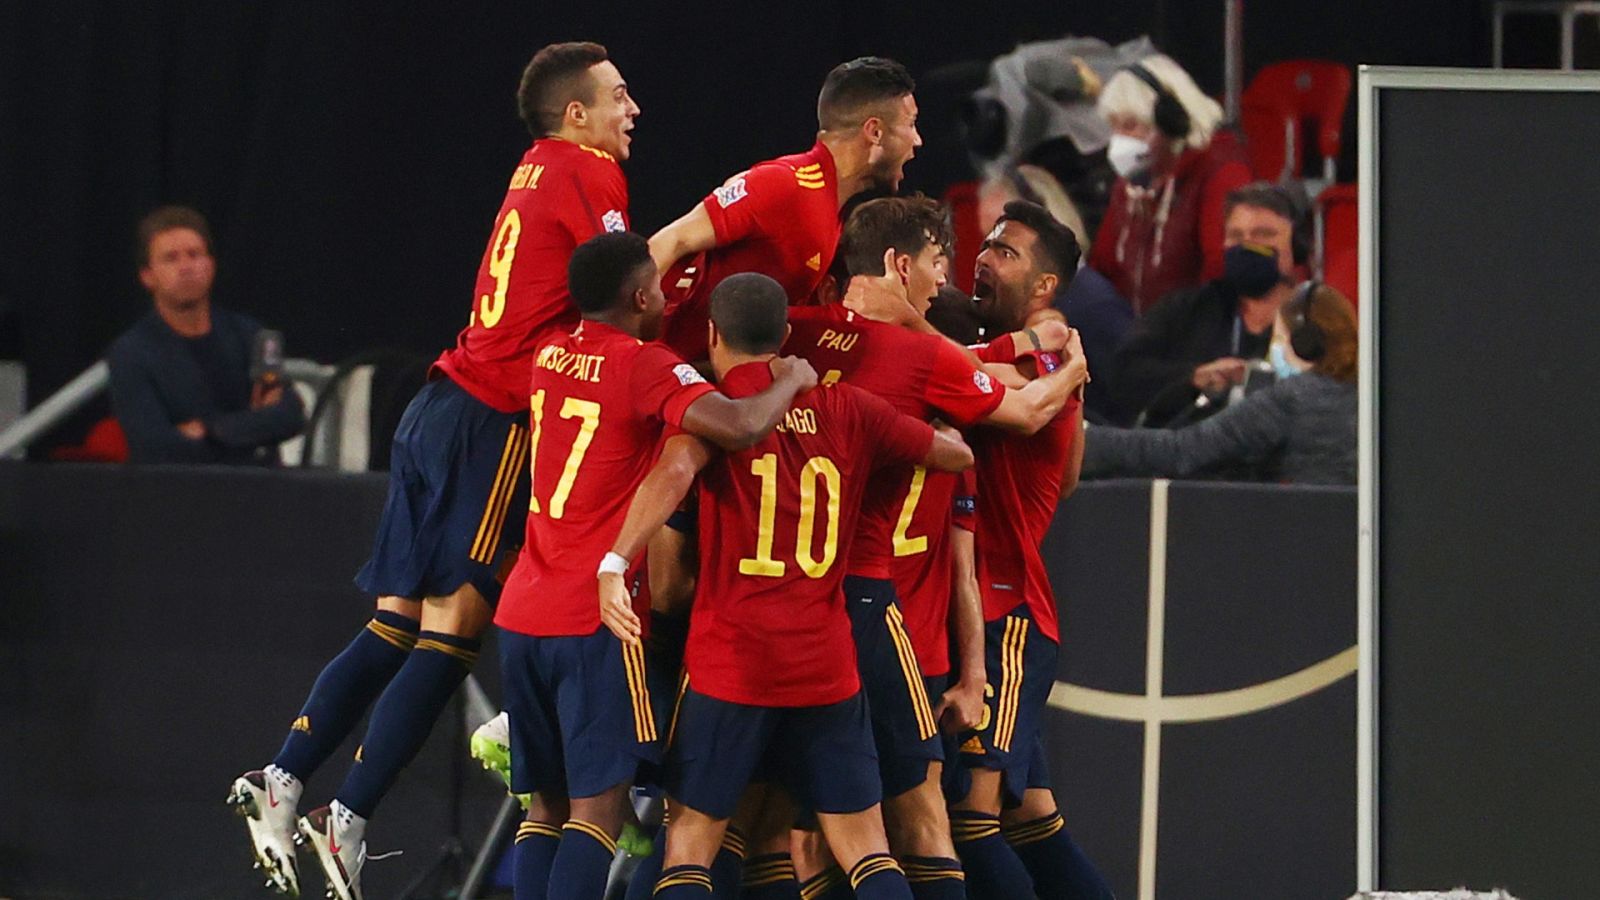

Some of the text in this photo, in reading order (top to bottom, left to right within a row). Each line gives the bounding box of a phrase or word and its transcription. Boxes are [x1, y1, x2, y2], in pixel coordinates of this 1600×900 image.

[469, 208, 522, 329] 9
[817, 329, 859, 352] PAU
[529, 389, 601, 519] 17
[738, 453, 841, 578] 10
